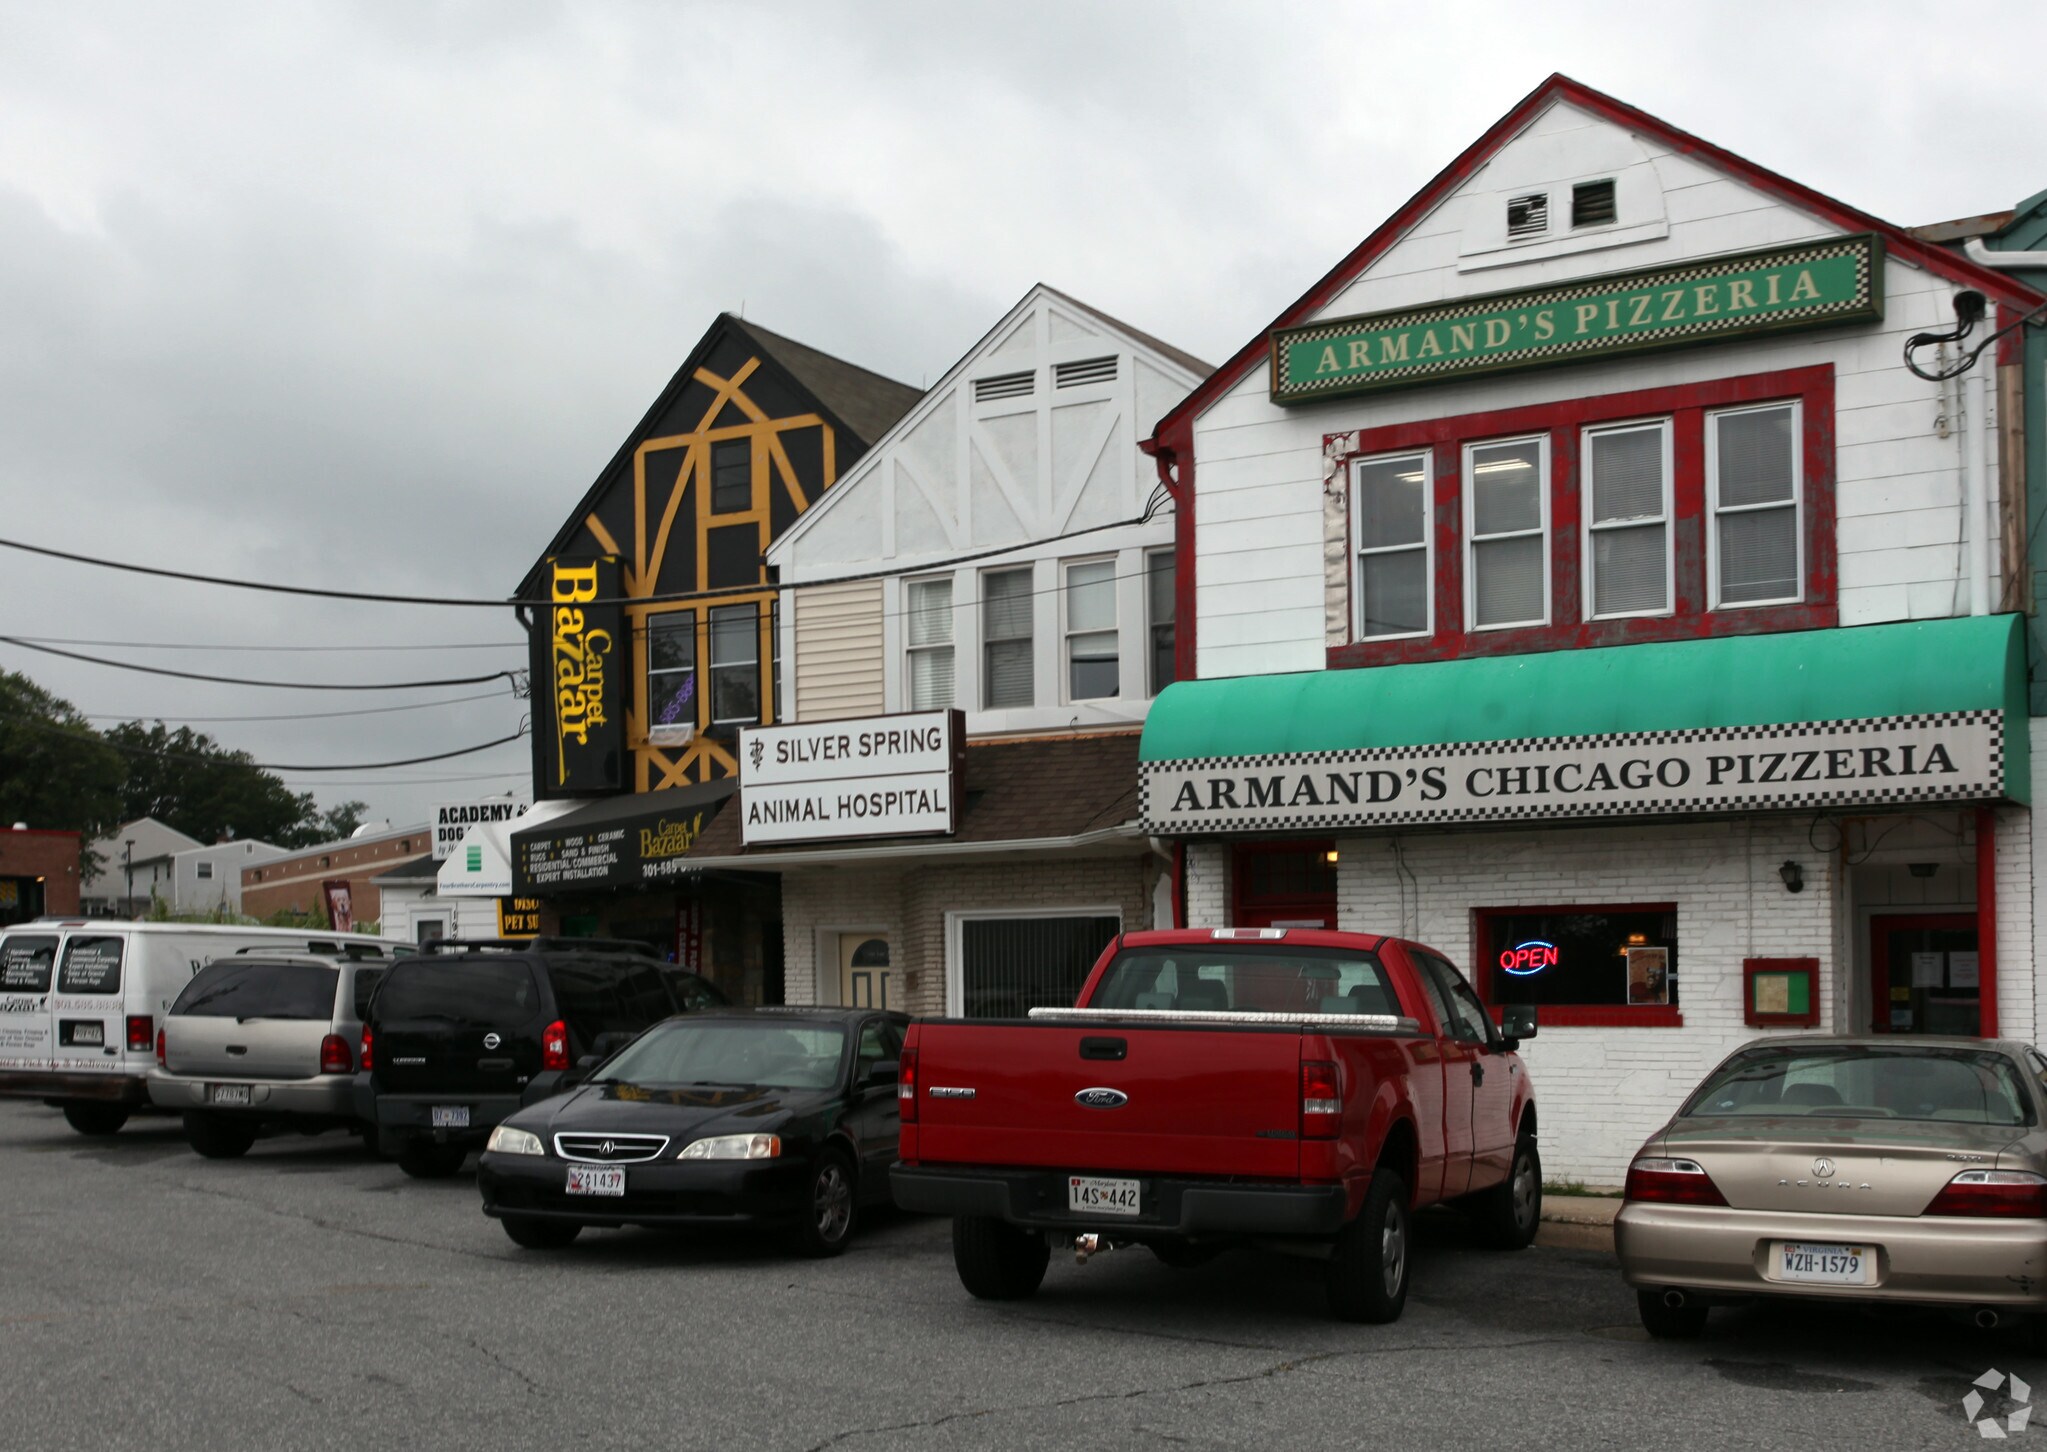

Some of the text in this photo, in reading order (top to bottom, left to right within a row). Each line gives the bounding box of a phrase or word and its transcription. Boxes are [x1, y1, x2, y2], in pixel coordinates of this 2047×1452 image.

[1315, 269, 1820, 374] ARMAND'S PIZZERIA
[551, 559, 598, 746] Bazaar
[583, 628, 613, 728] Carpet
[776, 727, 942, 764] SILVER SPRING
[1170, 742, 1958, 812] ARMAND'S CHICAGO PIZZERIA
[438, 804, 513, 825] ACADEMY
[748, 788, 947, 825] ANIMAL HOSPITAL
[438, 827, 464, 842] DOG
[658, 818, 688, 836] Carpet
[530, 829, 625, 852] CARPET WOOD CERAMIC
[640, 828, 693, 858] Bazaar
[530, 854, 546, 862] RUGS
[561, 849, 579, 859] SAND
[588, 844, 610, 855] FINISH
[536, 865, 608, 884] EXPERT INSTALLATION
[504, 914, 525, 930] PET
[1500, 947, 1558, 969] OPEN
[0, 1001, 39, 1013] azaar
[23, 1058, 43, 1067] Pick
[75, 1059, 116, 1070] Delivery
[1086, 1092, 1116, 1106] Ford
[1777, 1179, 1872, 1190] ACURA
[1803, 1246, 1844, 1255] VIRGINIA
[1784, 1253, 1860, 1274] WZH-1579
